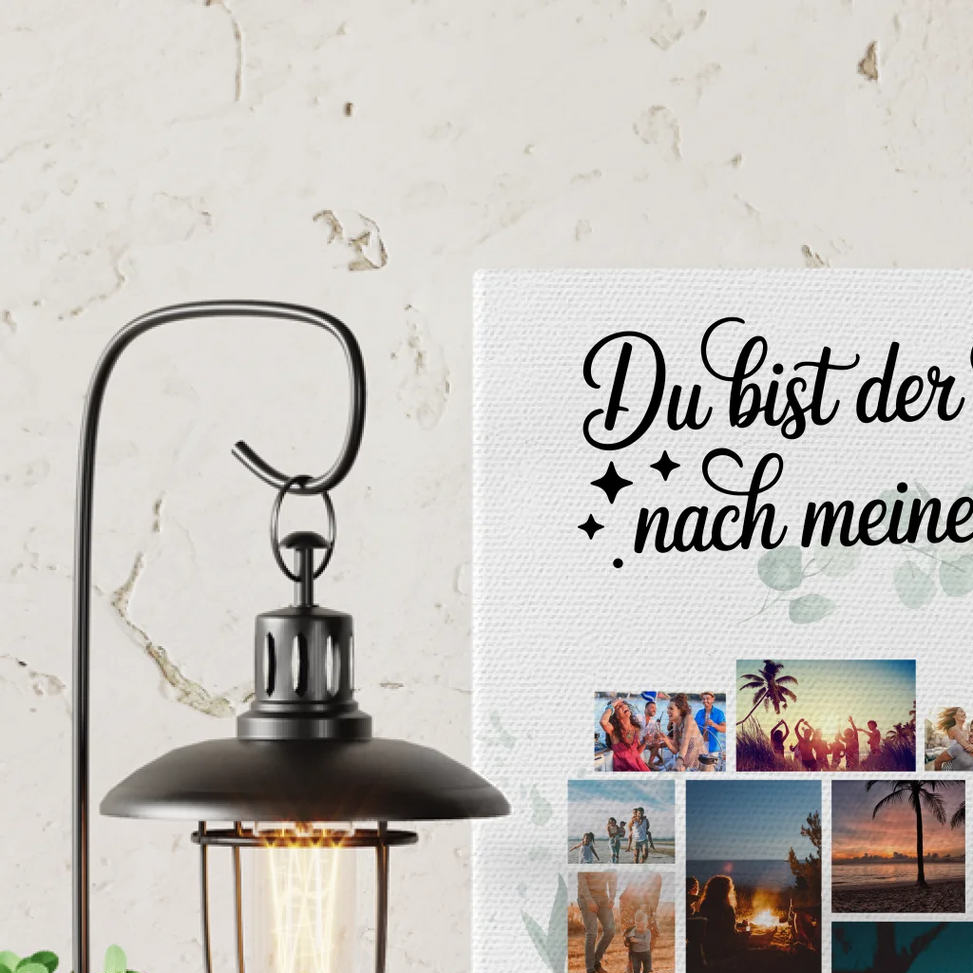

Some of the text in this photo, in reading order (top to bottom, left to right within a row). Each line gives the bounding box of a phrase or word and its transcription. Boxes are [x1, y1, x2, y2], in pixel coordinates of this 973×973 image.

[582, 330, 713, 451] Du
[700, 316, 860, 440] bist
[855, 341, 966, 424] der
[634, 447, 788, 554] nach
